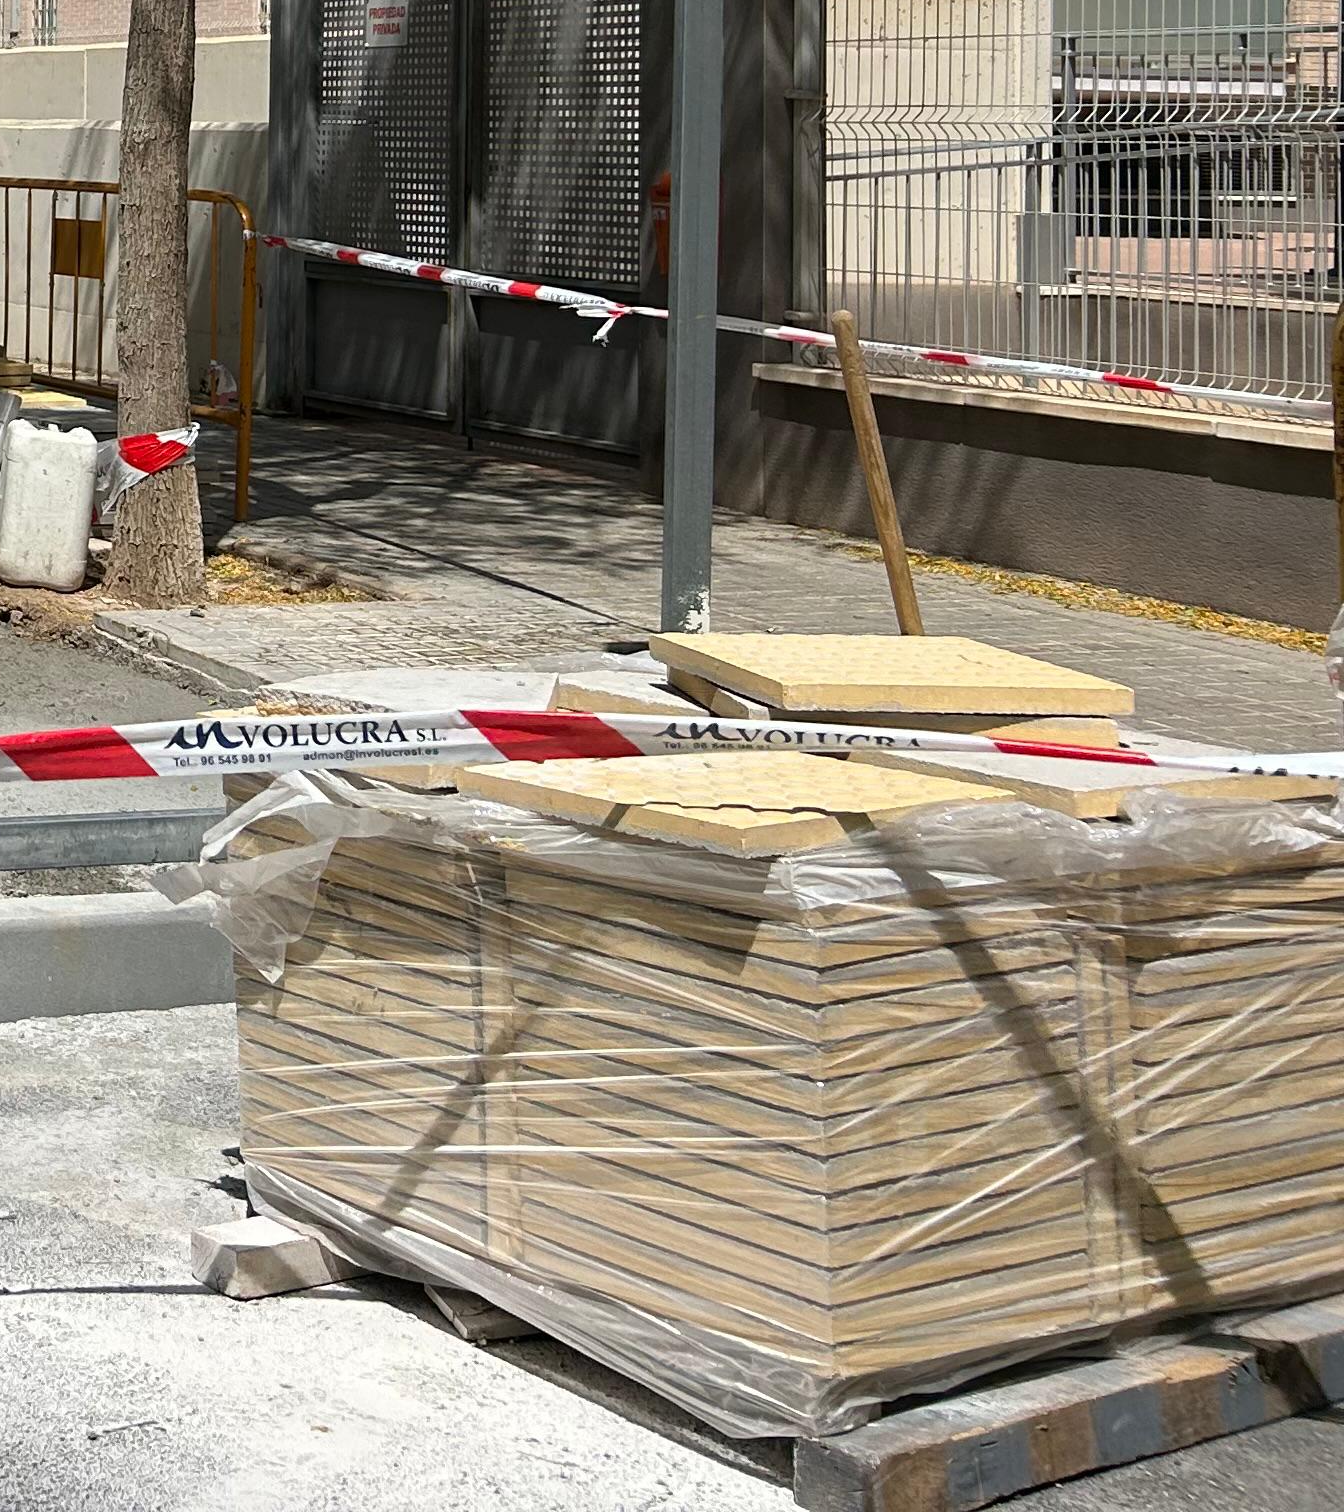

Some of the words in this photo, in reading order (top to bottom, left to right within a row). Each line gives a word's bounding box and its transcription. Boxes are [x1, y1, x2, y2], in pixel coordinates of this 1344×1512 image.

[369, 6, 406, 19] PROPIEDAD
[373, 23, 401, 35] PRIVADA
[416, 727, 447, 743] S.L.
[200, 755, 215, 766] 96
[218, 754, 239, 765] 545
